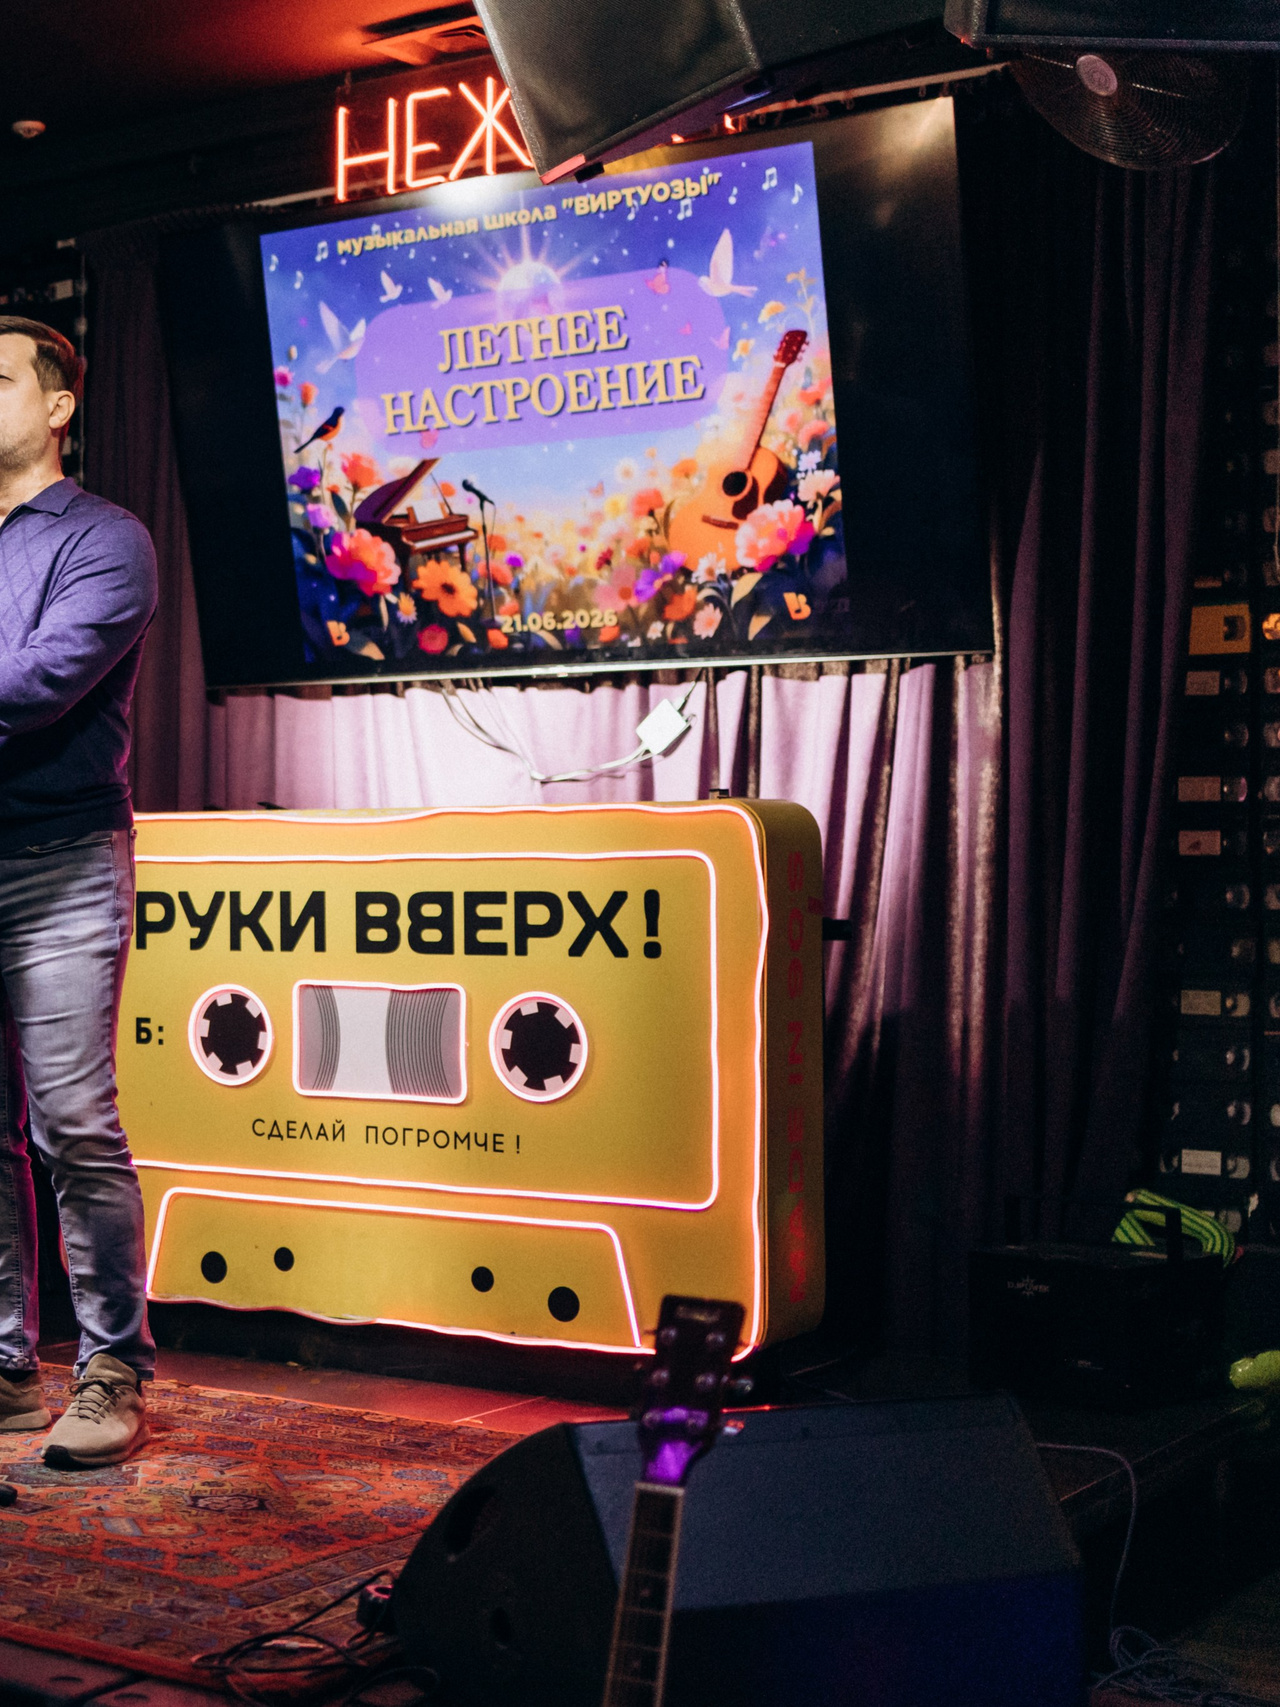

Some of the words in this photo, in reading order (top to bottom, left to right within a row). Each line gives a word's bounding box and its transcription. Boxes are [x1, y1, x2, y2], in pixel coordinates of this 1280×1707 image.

[483, 203, 558, 231] школа
[561, 173, 720, 217] "ВИРТУОЗЫ"
[437, 305, 630, 373] ЛЕТНЕЕ
[381, 354, 706, 436] НАСТРОЕНИЕ
[500, 608, 618, 634] 21.06.2026
[134, 890, 327, 953] РУКИ
[355, 888, 663, 960] ВВЕРХ!
[134, 1016, 165, 1046] Б:
[787, 1019, 806, 1085] IN
[251, 1117, 347, 1144] СДЕЛАЙ
